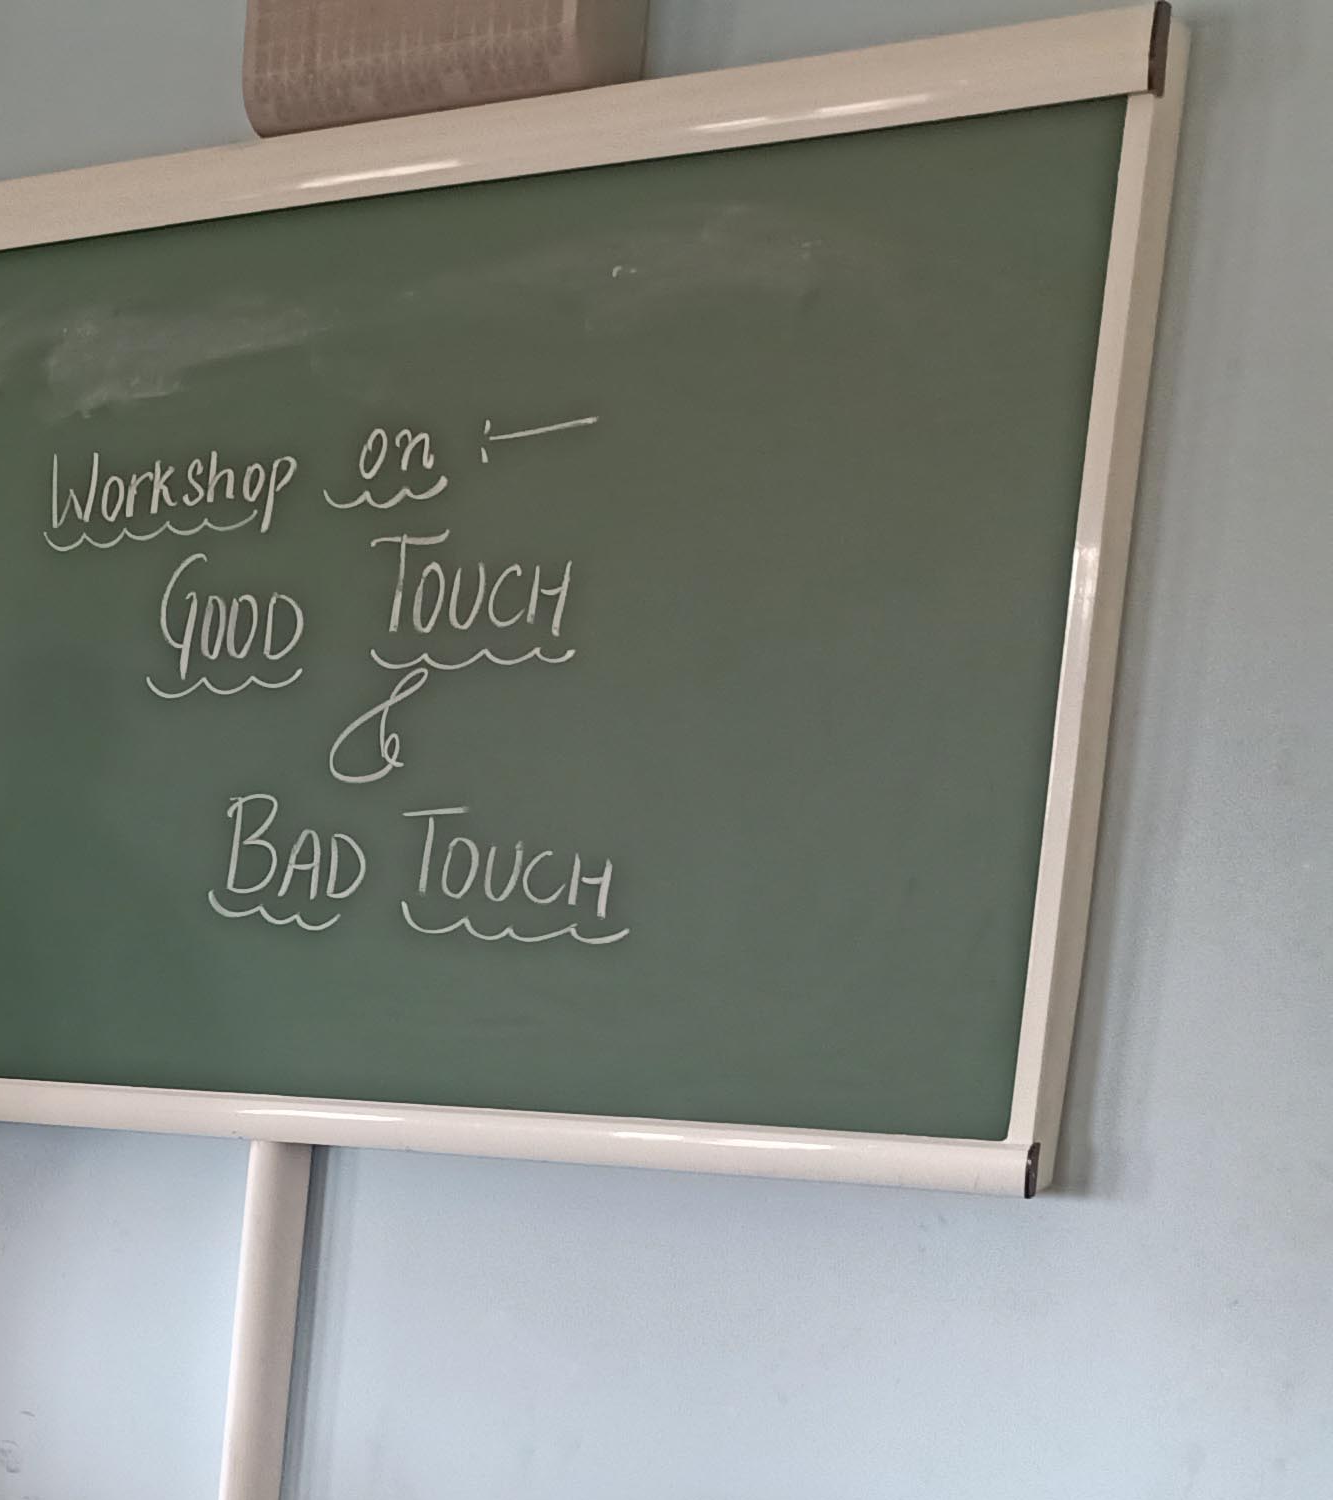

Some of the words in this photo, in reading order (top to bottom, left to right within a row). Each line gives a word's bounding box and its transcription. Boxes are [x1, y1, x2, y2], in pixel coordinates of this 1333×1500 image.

[51, 450, 297, 533] Workshop
[358, 428, 436, 478] on
[159, 553, 304, 680] GOOD
[370, 529, 573, 637] TOUCH
[329, 667, 429, 783] &
[226, 793, 366, 900] BAD
[401, 806, 613, 919] TOUCH
